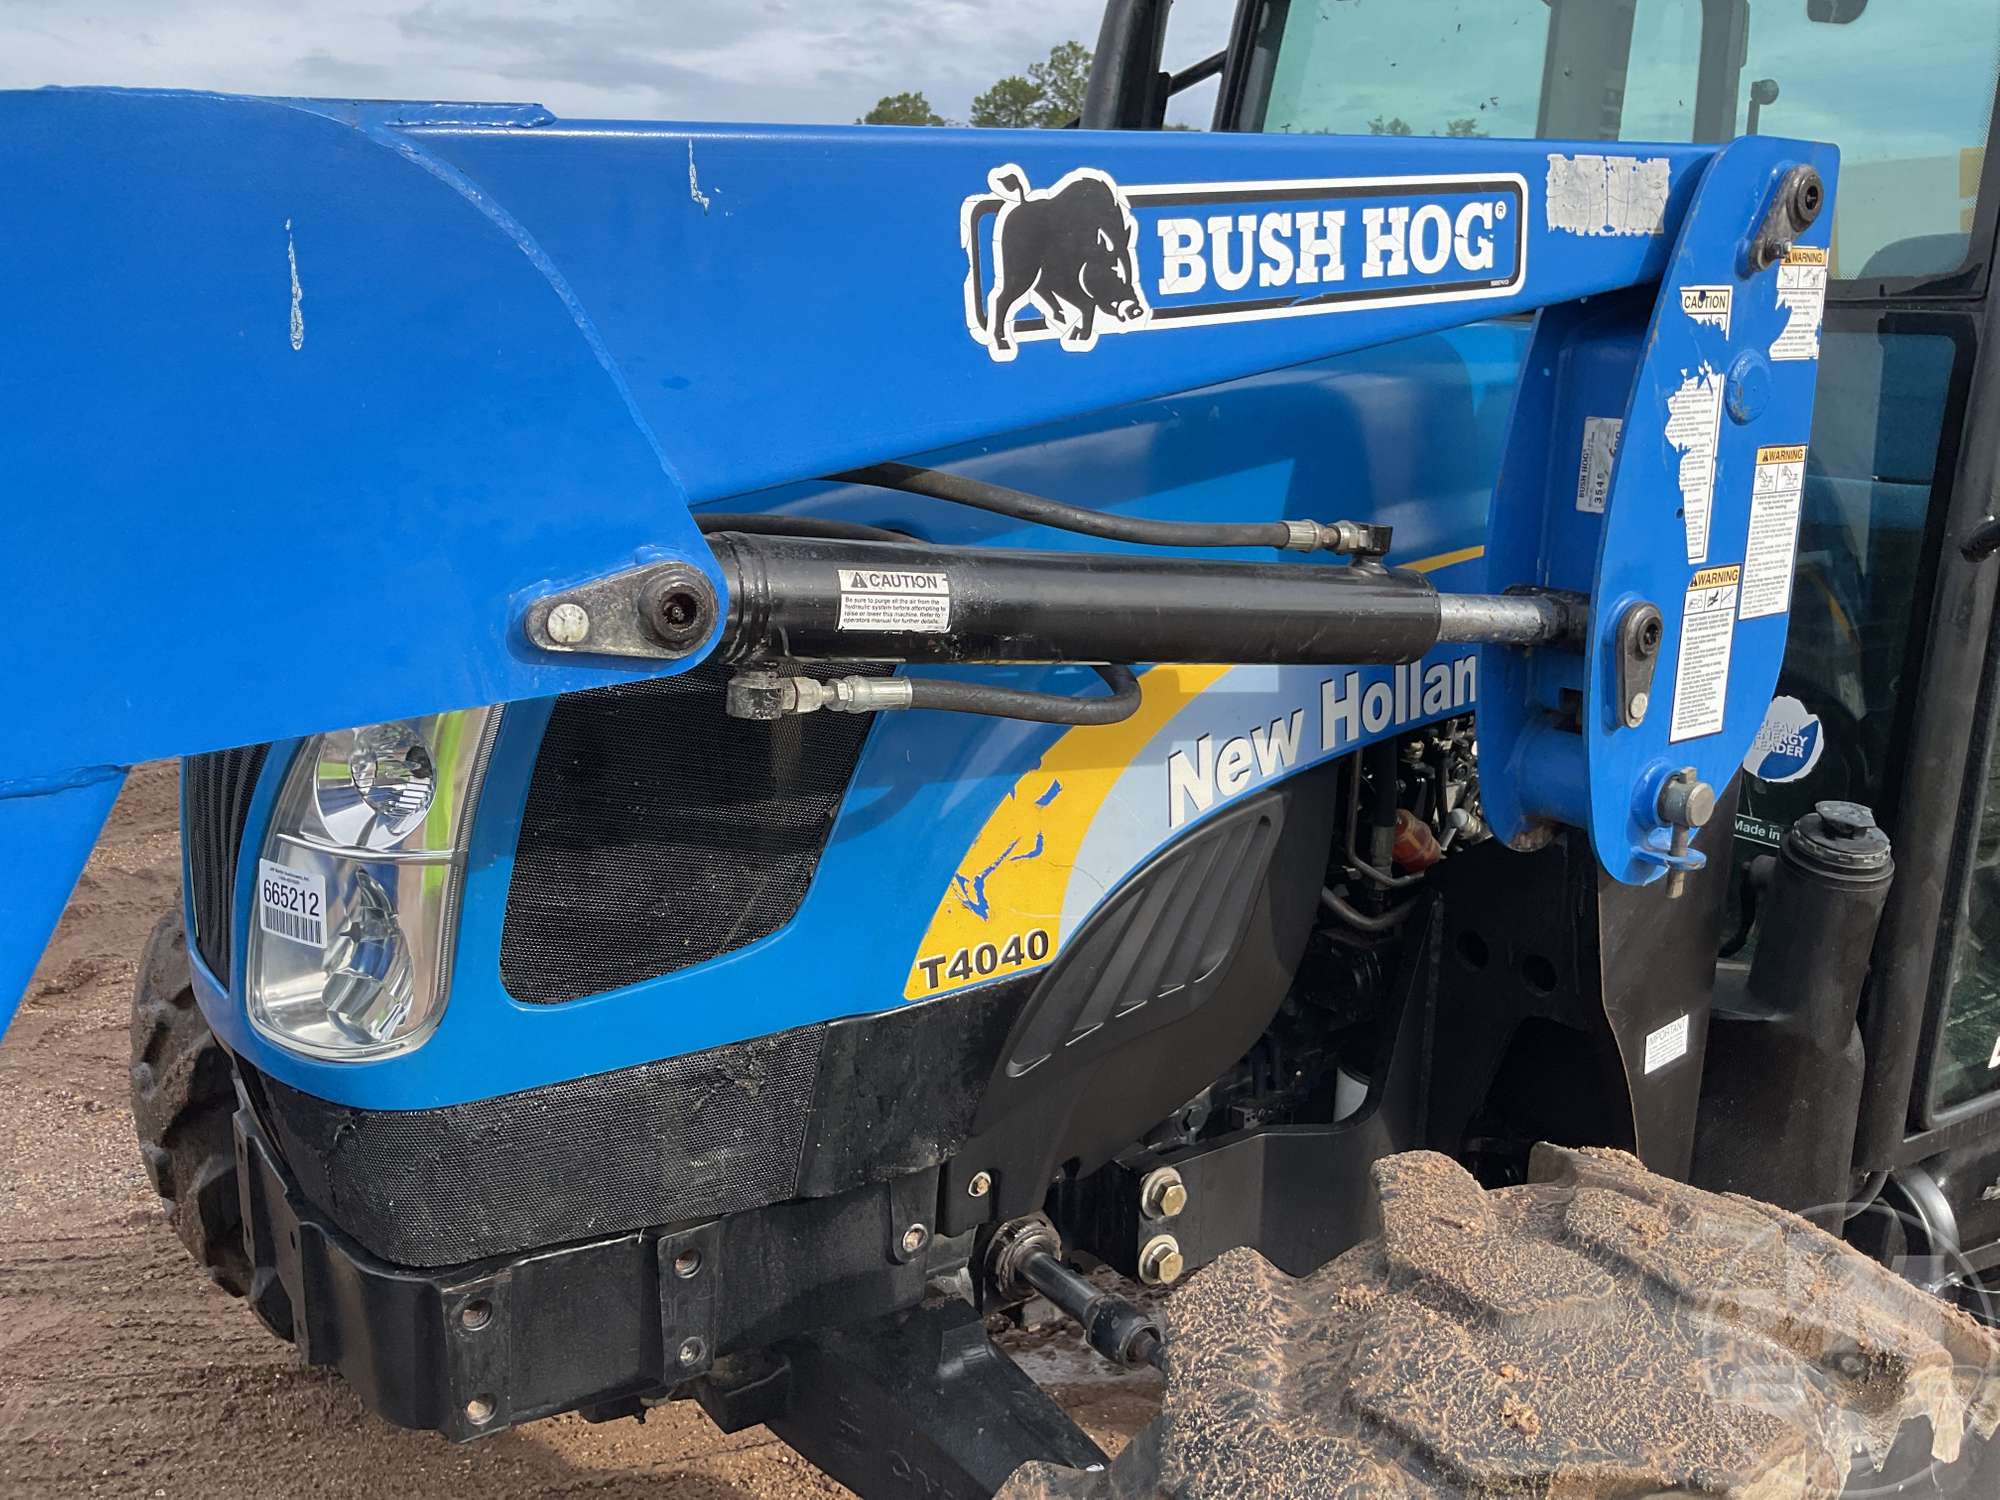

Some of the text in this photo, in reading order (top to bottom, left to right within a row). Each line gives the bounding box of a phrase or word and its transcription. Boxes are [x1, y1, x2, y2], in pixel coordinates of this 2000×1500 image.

[1157, 210, 1345, 295] BUSH
[1792, 252, 1823, 263] WARNING
[1684, 295, 1726, 309] CAUTION
[1769, 449, 1803, 461] WARNING
[870, 573, 938, 589] CAUTION
[1697, 569, 1739, 586] WARNING
[1168, 655, 1477, 829] New Hollan
[1769, 827, 1780, 841] in
[263, 879, 320, 917] 665212
[918, 929, 1050, 989] T4040
